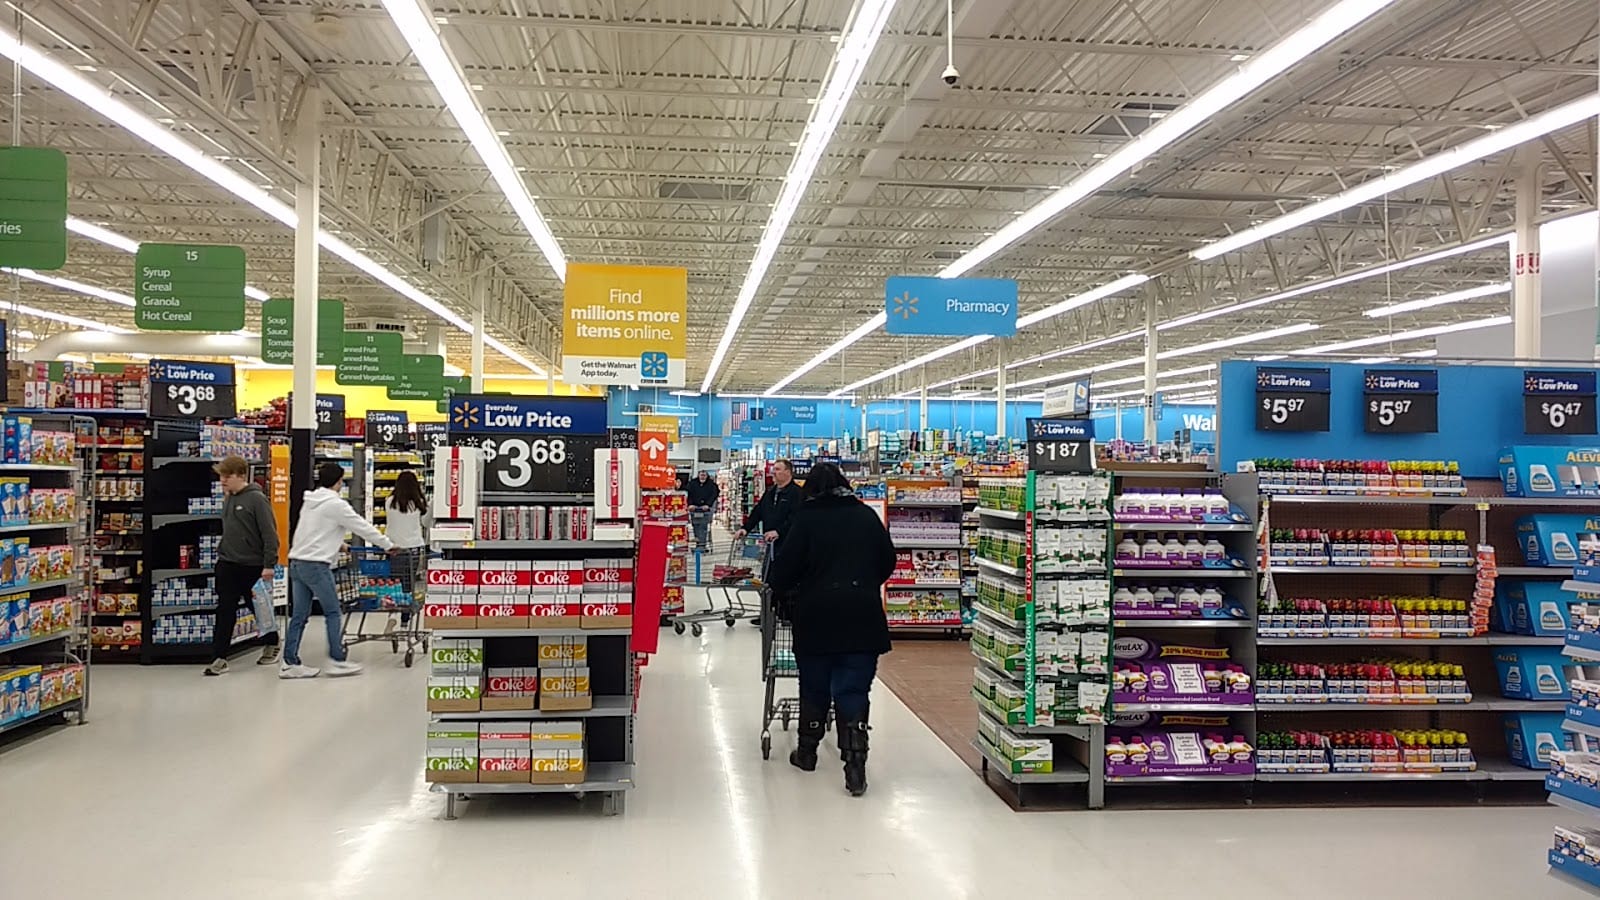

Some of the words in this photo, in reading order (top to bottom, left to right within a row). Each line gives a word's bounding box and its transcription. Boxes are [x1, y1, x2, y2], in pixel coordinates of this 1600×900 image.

[186, 251, 198, 261] 15
[143, 267, 171, 278] Syrup
[142, 282, 172, 292] Cereal
[142, 297, 180, 307] Granola
[609, 288, 642, 304] Find
[570, 305, 635, 322] millions
[637, 310, 680, 322] more
[946, 299, 1010, 316] Pharmacy
[142, 311, 161, 320] Hot
[162, 311, 192, 321] Cereal
[267, 316, 287, 325] Soup
[266, 327, 288, 336] Sauce
[576, 322, 622, 338] items
[623, 324, 674, 340] online.
[267, 350, 294, 360] Spaghe
[581, 360, 594, 368] Get
[594, 360, 606, 368] the
[607, 361, 637, 369] Walmart
[167, 370, 189, 379] Low
[190, 370, 215, 380] Price
[362, 373, 395, 382] Vegetables
[580, 369, 596, 377] App
[597, 370, 619, 378] today.
[1271, 378, 1288, 386] Low
[1289, 378, 1311, 387] Price
[1380, 380, 1397, 388] Low
[1398, 380, 1420, 389] Price
[1539, 381, 1556, 390] Low
[1557, 381, 1578, 390] Price
[316, 400, 333, 408] Price
[485, 404, 518, 413] Everyday
[484, 411, 523, 427] Low
[526, 411, 572, 428] Price
[1065, 426, 1085, 434] Price
[647, 465, 666, 473] Pickup
[429, 570, 465, 585] Coke
[481, 570, 518, 585] Coke
[534, 570, 570, 585] Coke
[585, 568, 620, 583] Coke
[426, 604, 462, 616] Coke
[479, 604, 515, 616] Coke
[531, 604, 567, 616] Coke
[583, 604, 619, 616] Coke
[434, 649, 469, 663] Coke
[540, 645, 574, 658] Coke
[489, 678, 524, 691] Coke
[542, 678, 576, 691] Coke
[429, 687, 465, 699] Coke
[429, 758, 464, 770] Coke
[481, 759, 516, 771] Coke
[534, 759, 569, 771] Coke
